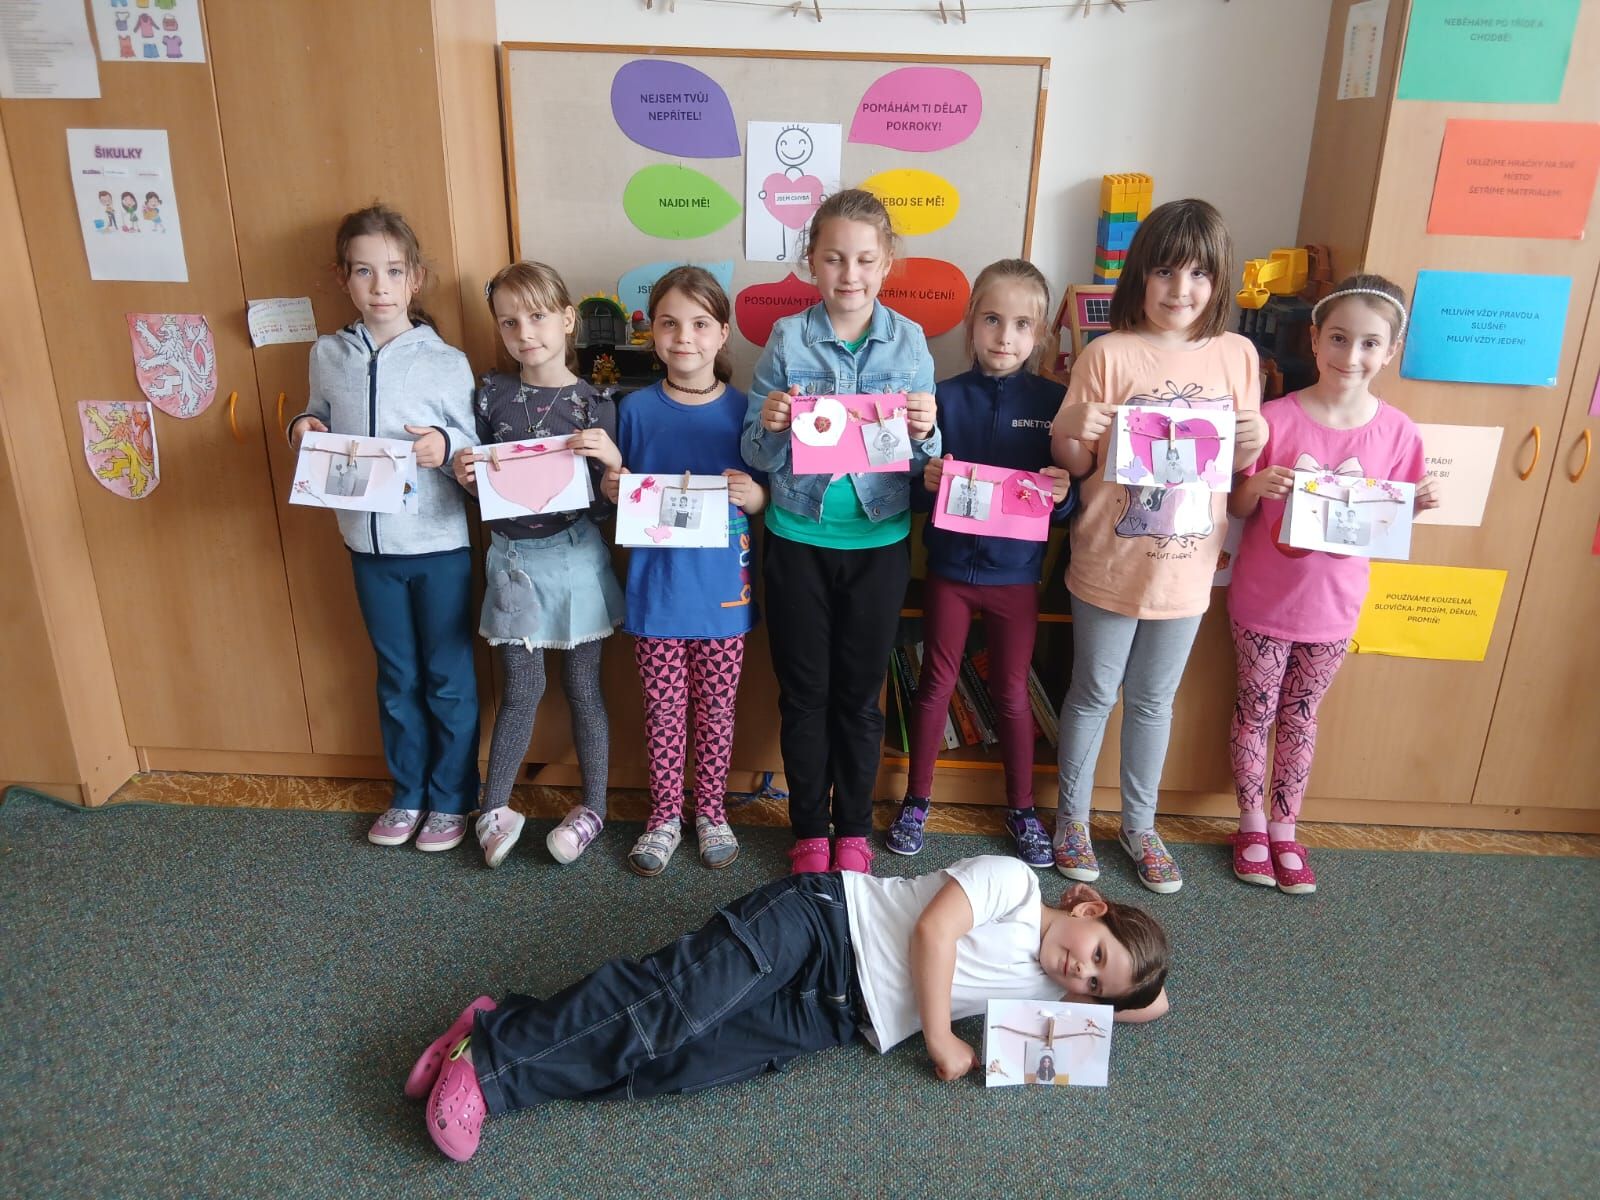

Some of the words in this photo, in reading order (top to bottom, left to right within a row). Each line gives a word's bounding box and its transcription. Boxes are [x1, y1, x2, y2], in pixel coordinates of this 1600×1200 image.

[640, 94, 681, 103] NEJSEM
[684, 92, 708, 103] TVŮJ
[862, 101, 919, 112] POMÁHÁM
[922, 104, 931, 112] TI
[934, 102, 967, 114] DĚLAT
[648, 110, 702, 120] NEPŘÍTEL!
[886, 121, 941, 131] POKROKY!
[94, 145, 142, 159] ŠIKULKY
[659, 198, 689, 208] NAJDI
[692, 196, 710, 208] MĚ!
[910, 197, 923, 206] SE
[926, 194, 945, 206] MĚ!
[880, 288, 908, 298] ATŘÍM
[910, 290, 918, 298] K
[919, 288, 955, 300] UČENÍ!
[744, 296, 802, 305] POSOUVÁM
[1441, 308, 1474, 316] MLUVÍM
[1477, 308, 1498, 318] VŽDY
[1500, 311, 1532, 320] PRAVDU
[1447, 334, 1472, 342] MLUVÍ
[1475, 335, 1496, 344] VŽDY
[1011, 419, 1052, 429] BENETTO
